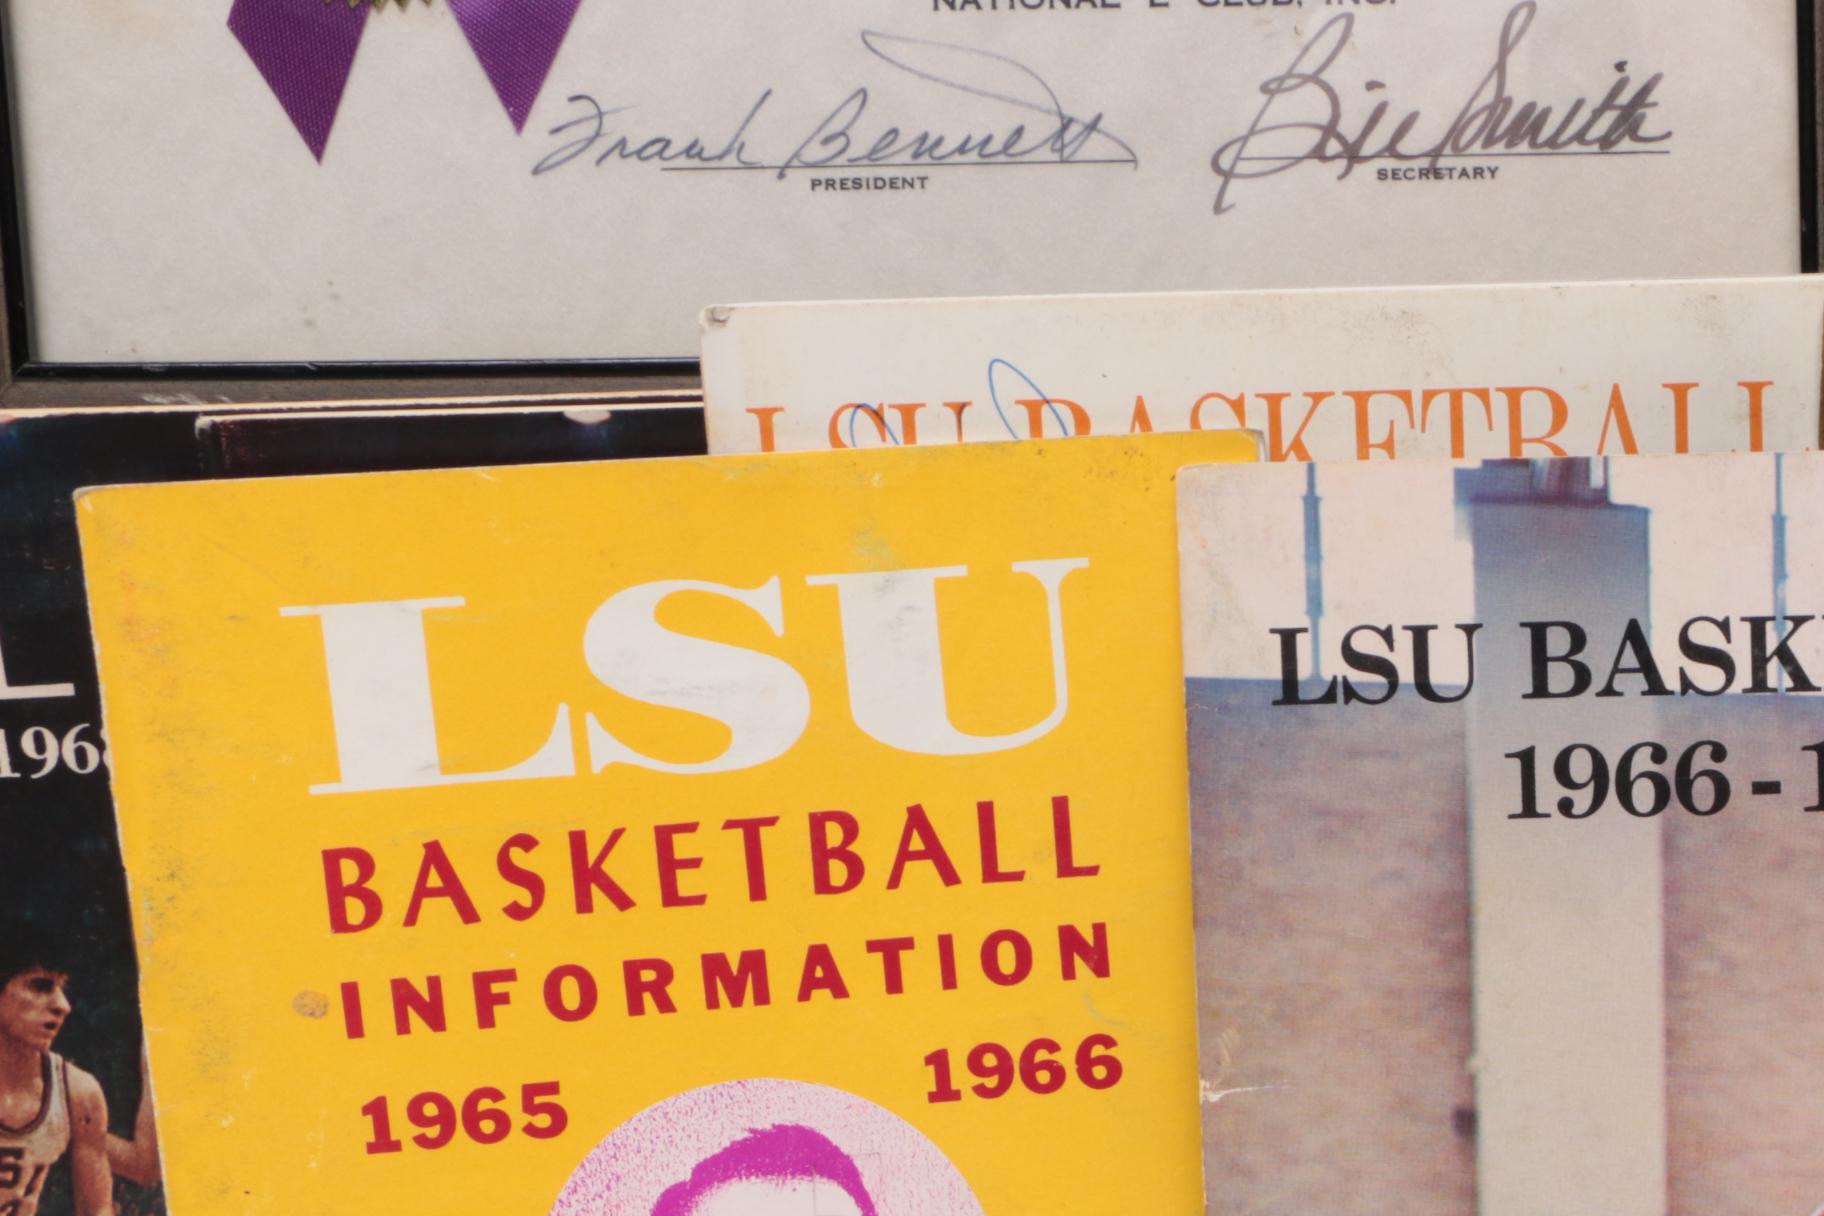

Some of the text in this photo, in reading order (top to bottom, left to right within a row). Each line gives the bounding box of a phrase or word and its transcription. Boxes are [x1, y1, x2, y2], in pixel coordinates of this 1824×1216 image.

[531, 88, 763, 176] Frank
[1376, 165, 1500, 182] SECRETARY
[810, 175, 930, 192] PRESIDENT
[278, 556, 1090, 796] LSU
[1267, 621, 1484, 707] LSU
[320, 794, 1102, 935] BASKETBALL
[339, 921, 1113, 1040] INFORMATION
[923, 1033, 1126, 1105] 1966
[360, 1080, 570, 1156] 1965
